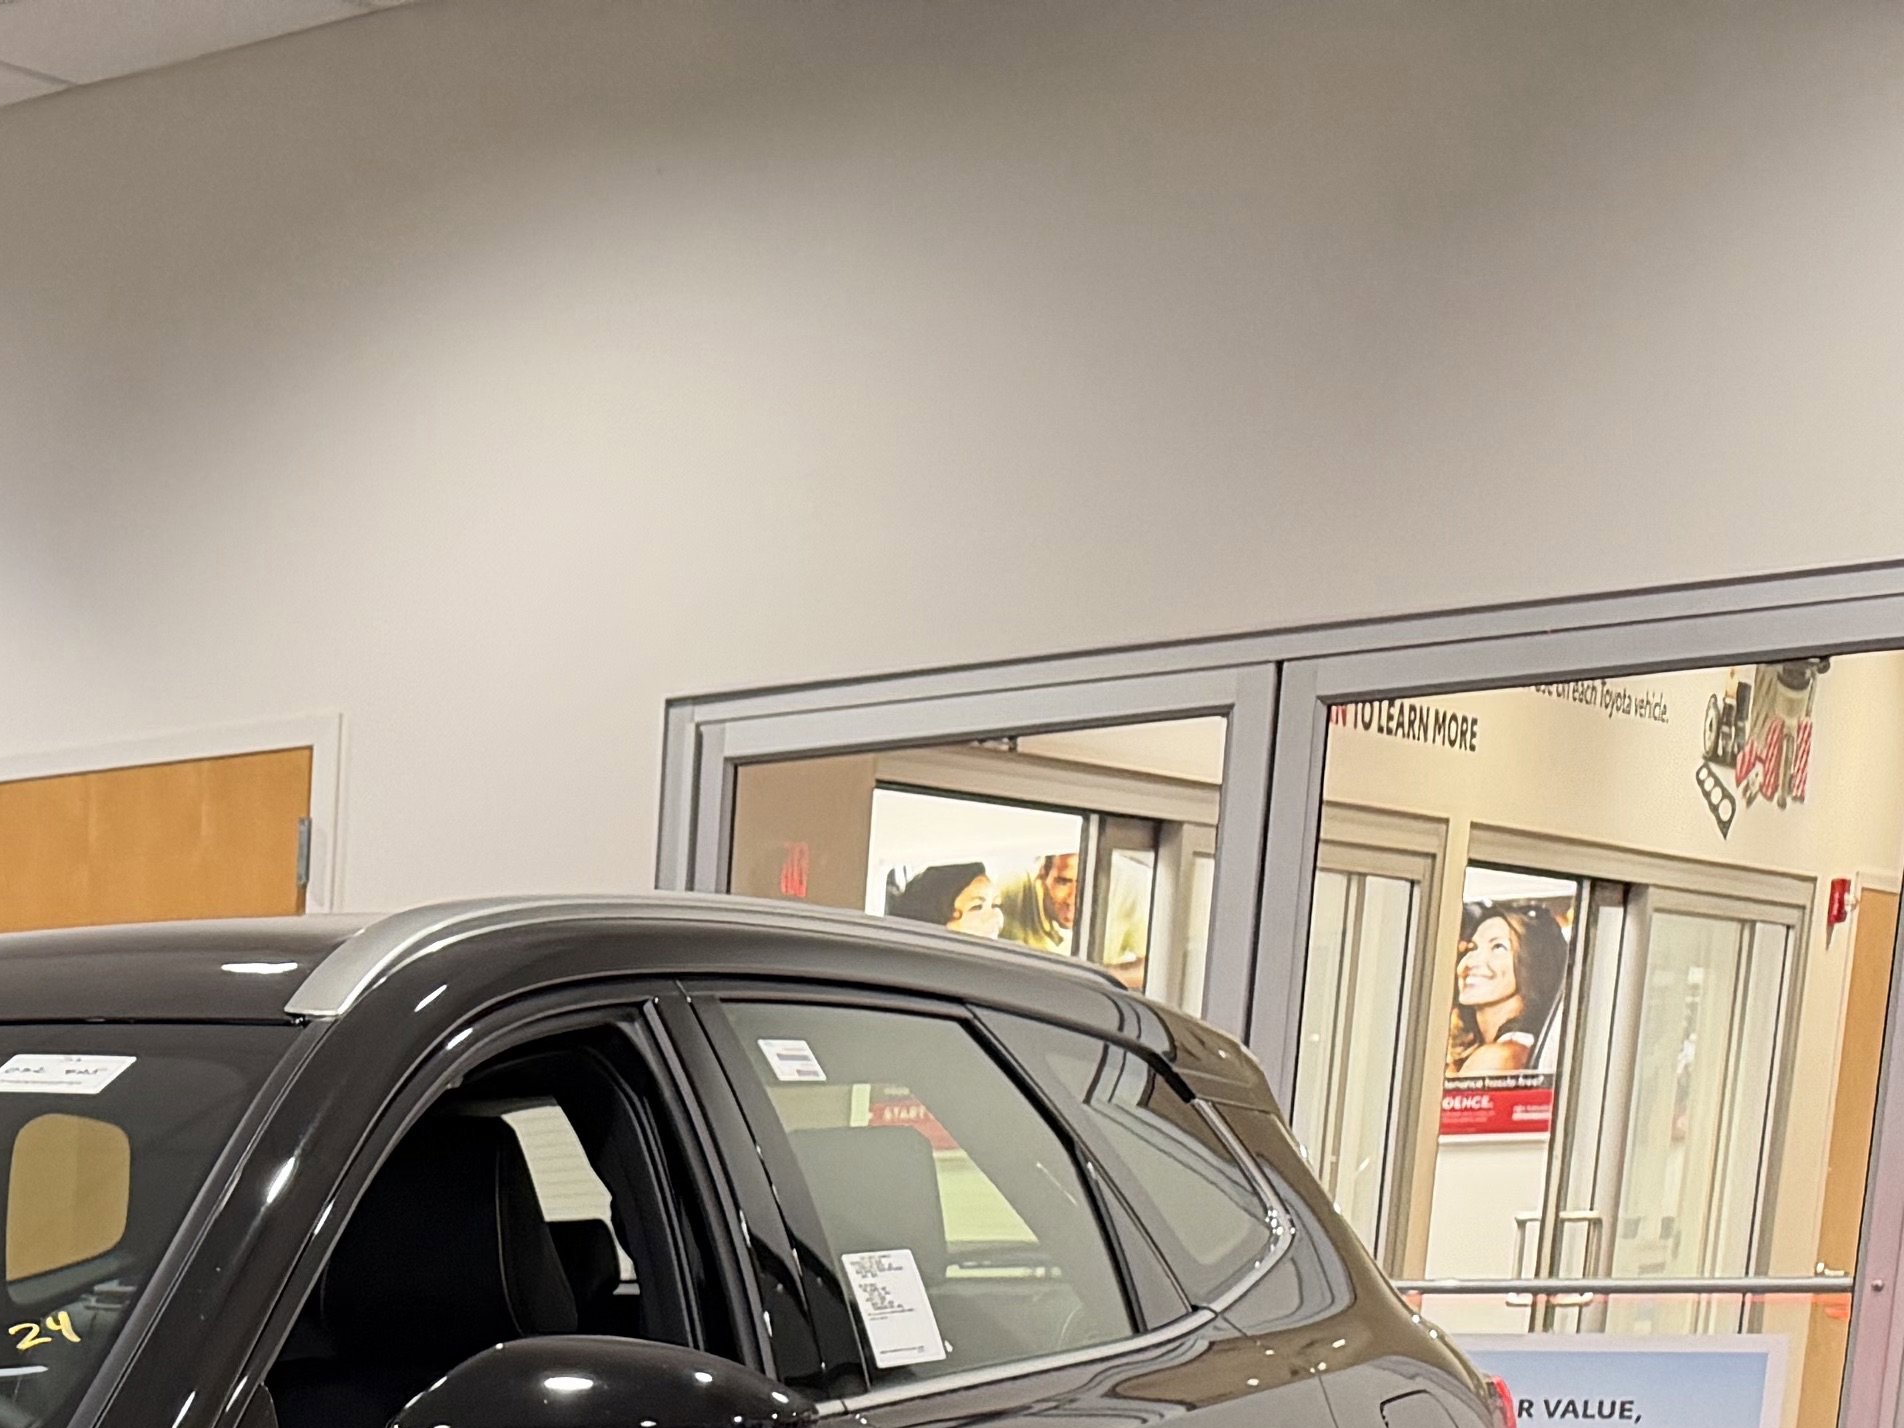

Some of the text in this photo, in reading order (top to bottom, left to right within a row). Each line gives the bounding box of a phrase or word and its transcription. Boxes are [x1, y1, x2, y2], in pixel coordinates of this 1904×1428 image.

[1600, 680, 1632, 718] Toyota
[1634, 688, 1670, 723] vehicle.
[1377, 701, 1429, 743] LEARN
[1433, 708, 1478, 752] MORE
[8, 1311, 81, 1351] 24
[1544, 1399, 1642, 1424] VALUE,
